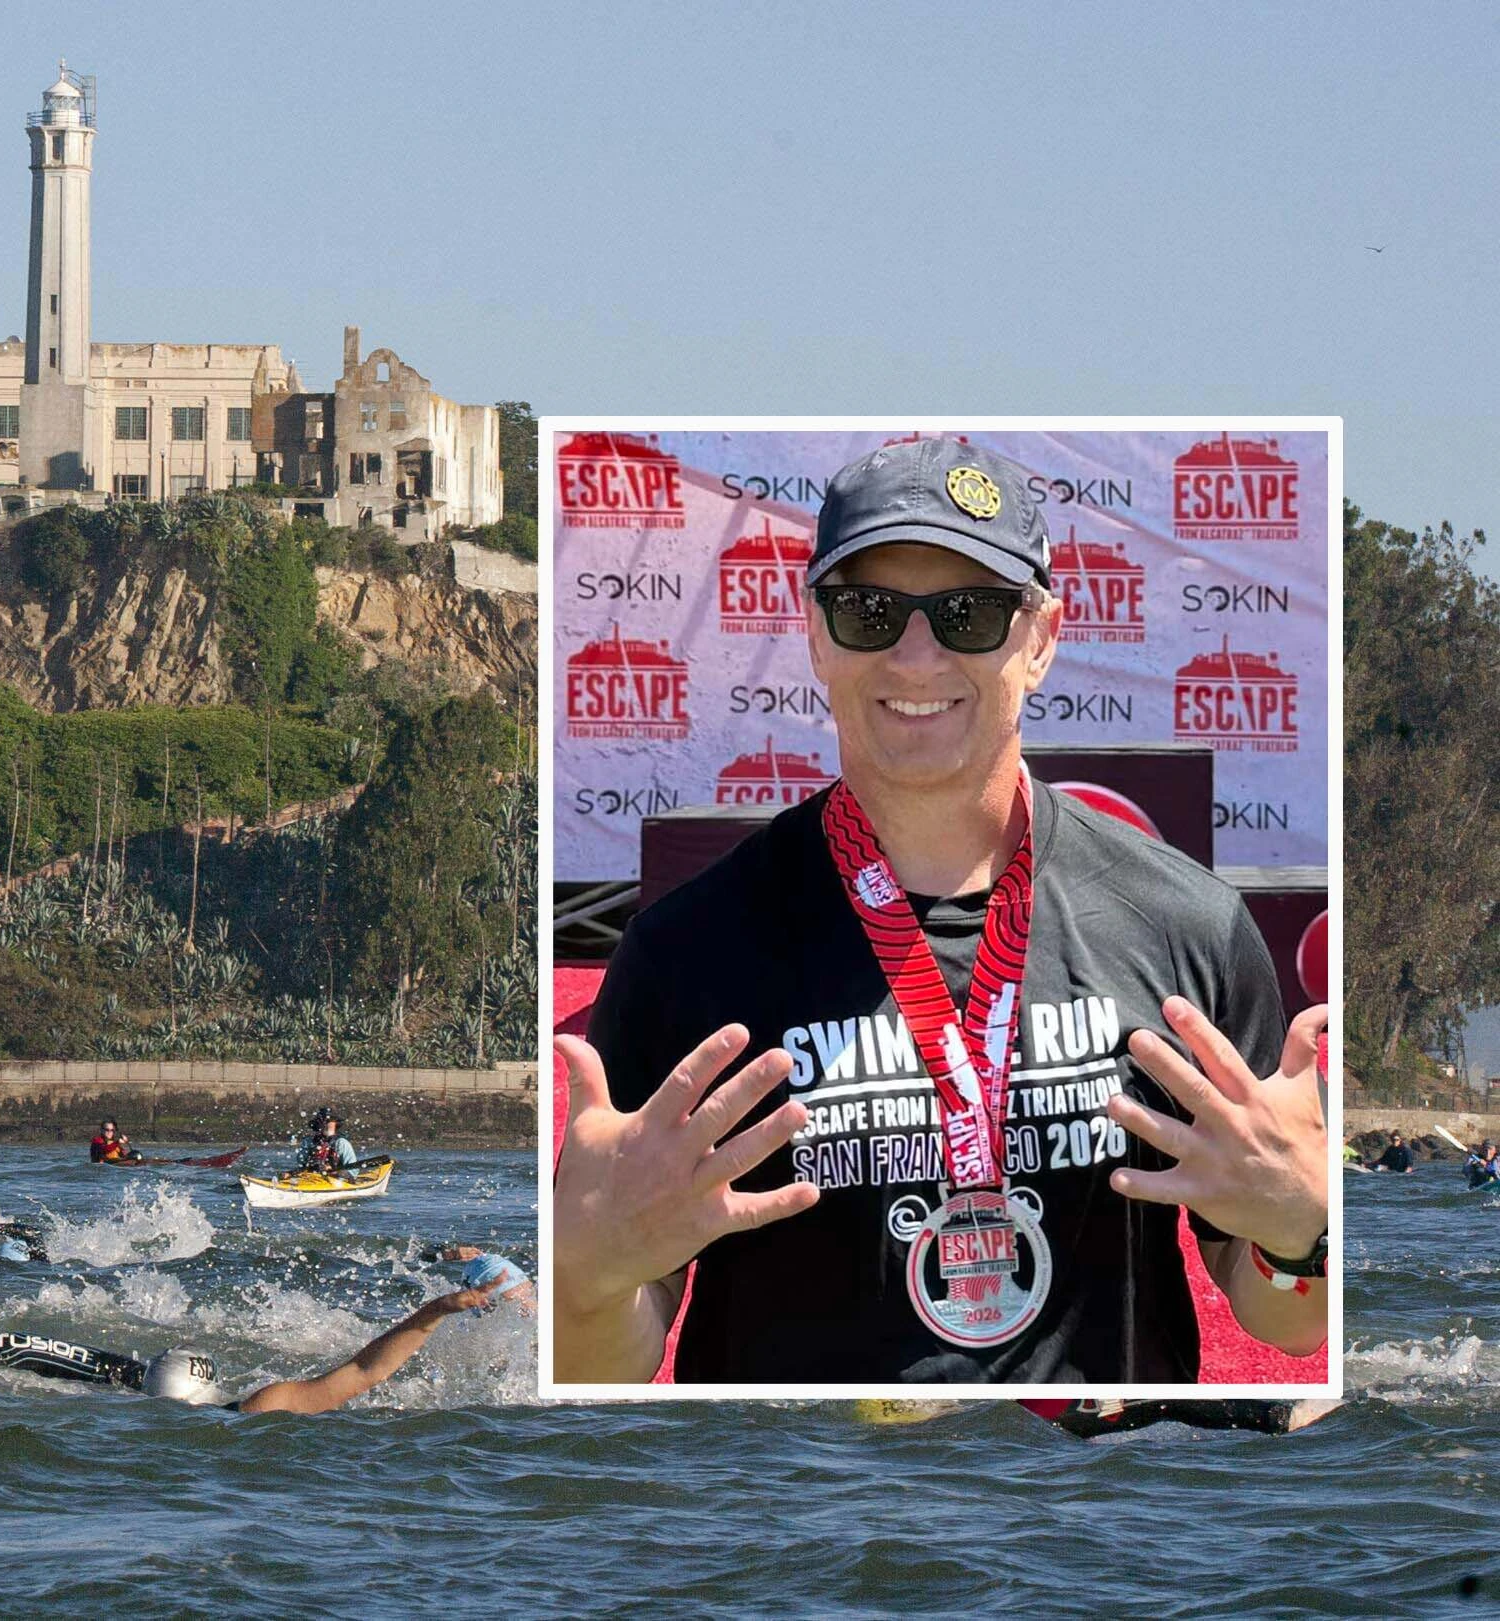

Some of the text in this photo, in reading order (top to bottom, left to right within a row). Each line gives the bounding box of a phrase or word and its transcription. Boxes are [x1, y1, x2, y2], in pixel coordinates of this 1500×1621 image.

[559, 464, 684, 508] ESCAPE
[722, 474, 828, 501] SOKIN
[1027, 476, 1132, 507] SOKIN
[1174, 474, 1298, 519] ESCAPE
[577, 572, 681, 600] SOKIN
[720, 569, 802, 614] ESCA
[1051, 577, 1144, 622] CAPE
[1182, 584, 1288, 613] SOKIN
[568, 673, 688, 719] ESCAPE
[1026, 693, 1132, 722] SOKIN
[1175, 685, 1298, 731] ESCAPE
[575, 788, 678, 815] SOKIN
[782, 1012, 919, 1087] SWIM
[1030, 995, 1120, 1064] RUN
[793, 1100, 868, 1139] SCAPE
[871, 1096, 926, 1128] FROM
[793, 1138, 863, 1190] SAN
[1047, 1115, 1127, 1170] 2026
[948, 1104, 984, 1189] ESCAPE
[941, 1228, 1016, 1264] ESCAPE
[964, 1306, 1003, 1325] 2026
